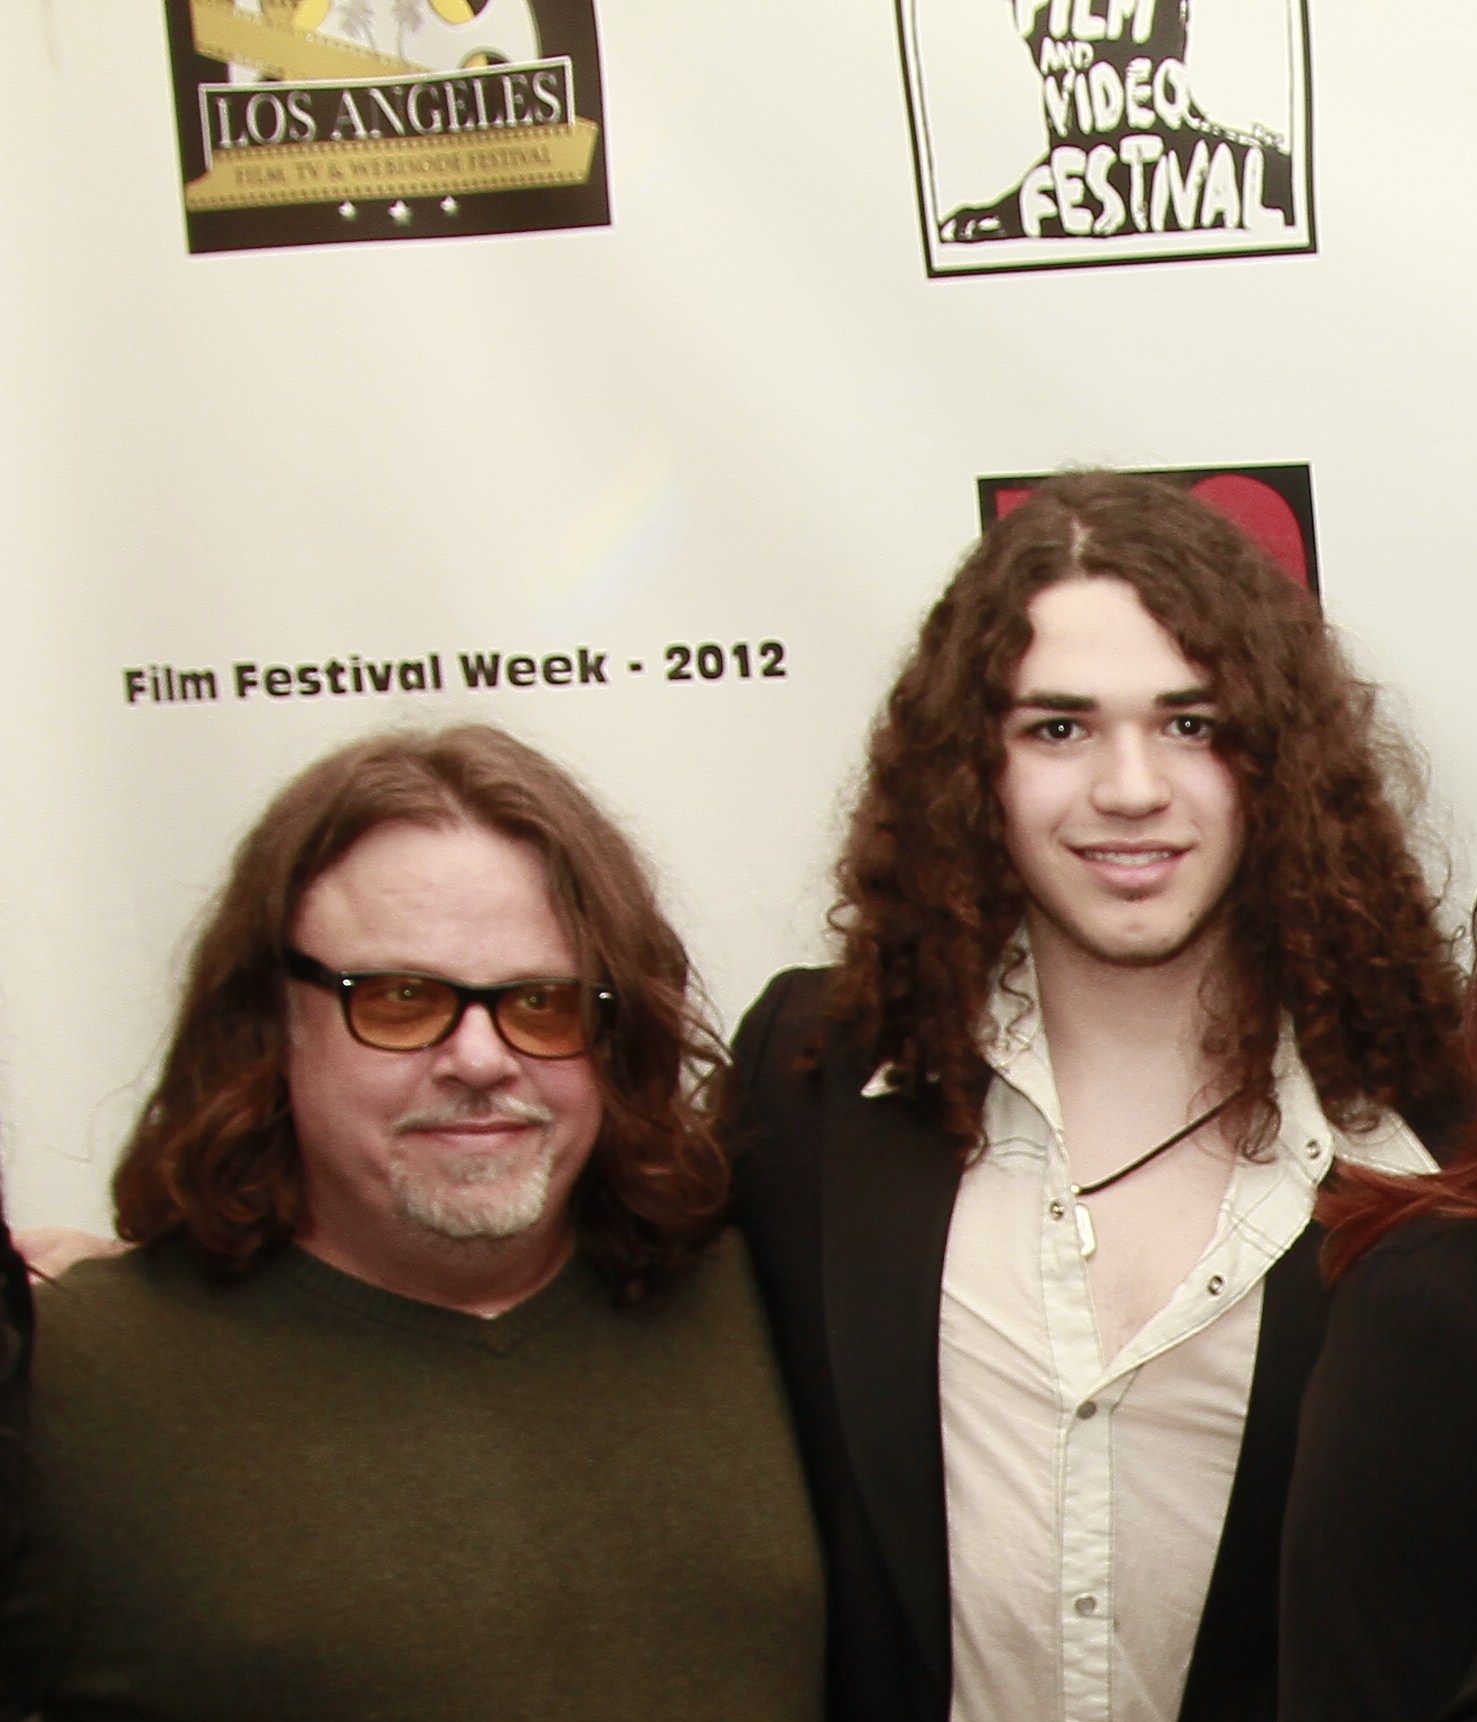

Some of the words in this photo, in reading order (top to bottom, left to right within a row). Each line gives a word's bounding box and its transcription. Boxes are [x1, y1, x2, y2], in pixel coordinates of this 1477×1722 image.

[1040, 36, 1095, 75] AND
[217, 90, 318, 148] LOS
[330, 71, 562, 140] ANGELES
[1044, 57, 1192, 138] VIDEO
[1019, 134, 1286, 238] FESTIVAL
[124, 664, 219, 705] Film
[233, 652, 444, 700] Festival
[458, 647, 608, 690] Week
[664, 640, 789, 682] 2012
